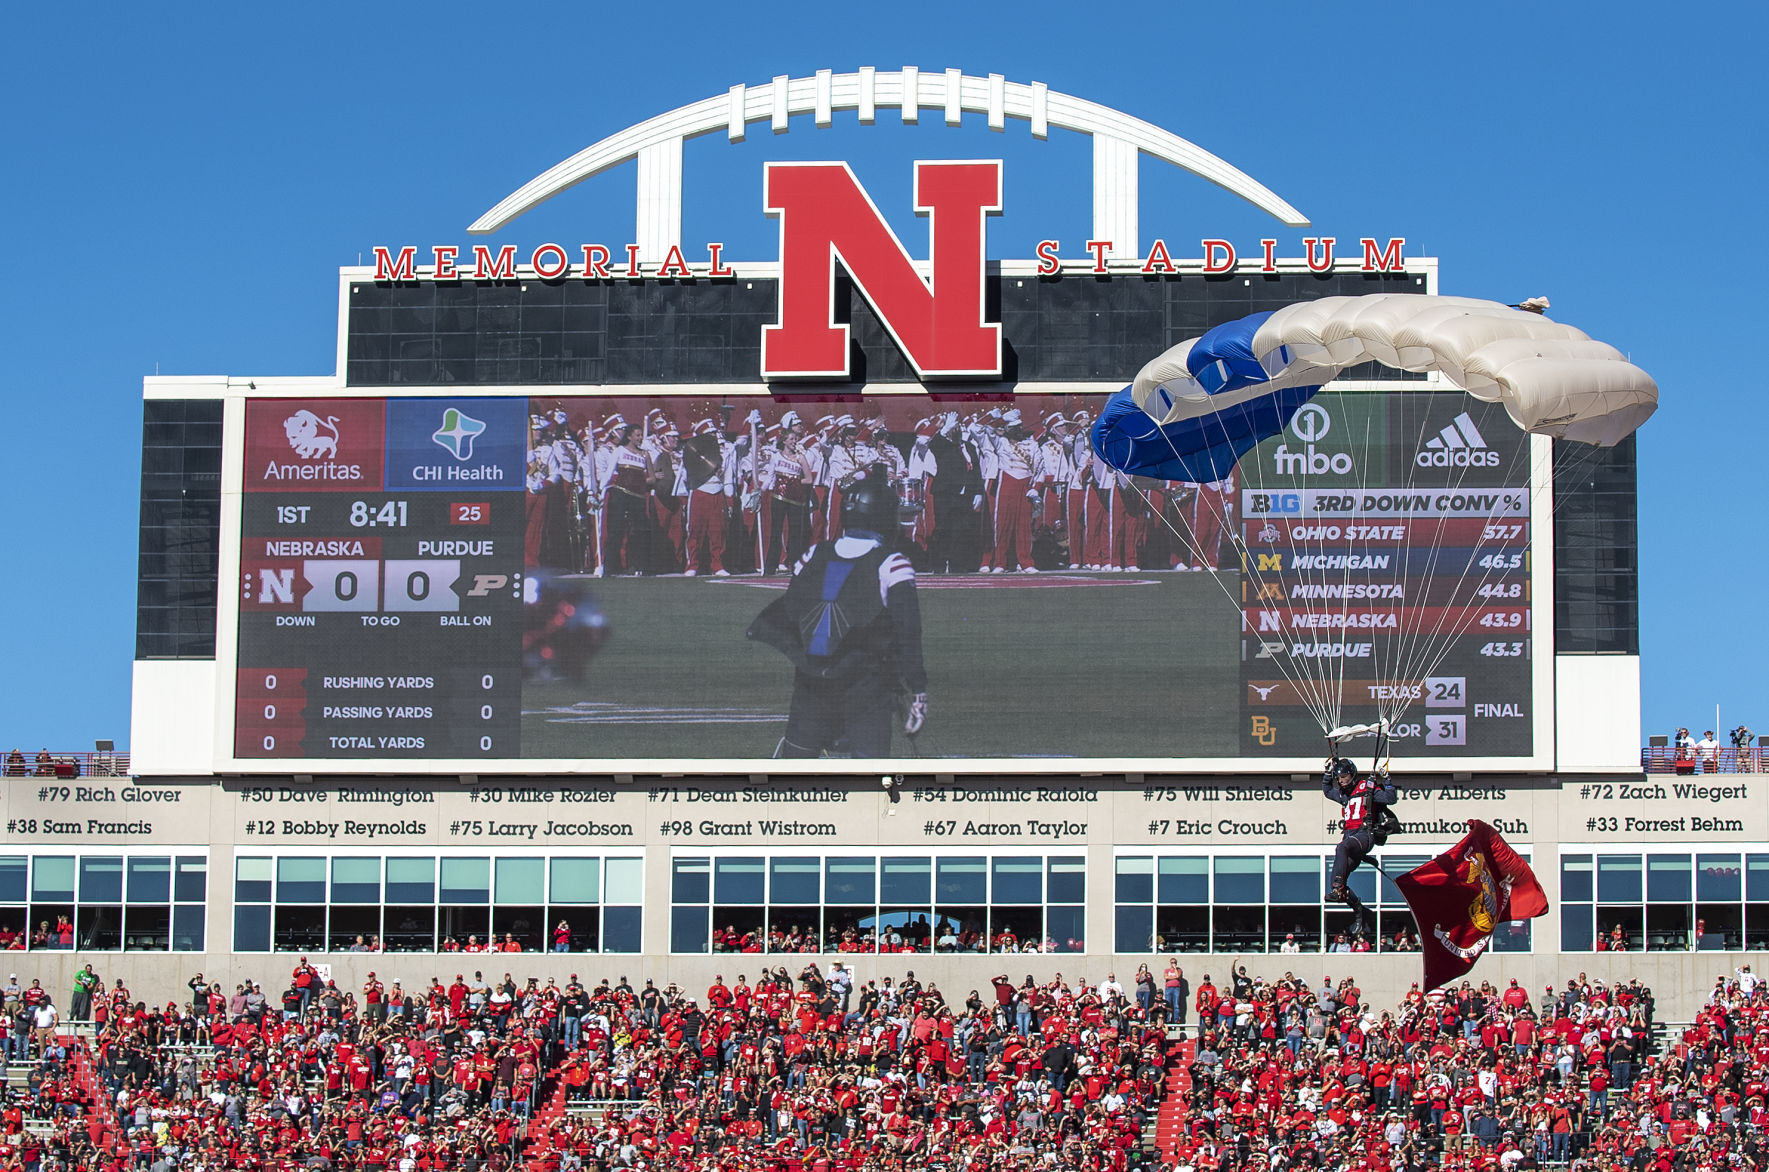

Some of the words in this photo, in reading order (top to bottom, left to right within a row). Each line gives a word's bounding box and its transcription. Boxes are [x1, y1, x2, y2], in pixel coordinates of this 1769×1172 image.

[373, 243, 733, 281] MEMORIAL
[1036, 237, 1405, 275] STADIUM
[761, 159, 1003, 376] N
[1274, 444, 1352, 474] fnbo
[1416, 448, 1500, 467] adidas
[263, 460, 361, 480] Ameritas
[412, 466, 442, 480] CHI
[448, 464, 504, 480] Health
[1313, 496, 1356, 512] 3RD
[1360, 496, 1433, 512] DOWN
[1435, 495, 1500, 511] CONV
[1503, 494, 1522, 511] %
[277, 506, 310, 524] 1ST
[350, 501, 408, 526] 8:41
[458, 506, 481, 522] 25
[1292, 526, 1340, 540] OHIO
[1344, 525, 1406, 540] STATE
[1482, 526, 1522, 540] 57.7
[266, 541, 364, 556] NEBRASKA
[418, 540, 494, 556] PURDUE
[1258, 554, 1282, 571] M
[1291, 556, 1390, 570] MICHIGAN
[1478, 555, 1522, 570] 46.5
[259, 568, 295, 604] N
[334, 570, 358, 601] 0
[406, 570, 430, 601] 0
[466, 574, 508, 597] P
[1291, 584, 1404, 599] MINNESOTA
[1478, 584, 1522, 598] 44.8
[276, 616, 316, 626] DOWN
[361, 616, 378, 626] TO
[380, 616, 400, 626] GO
[440, 616, 470, 626] BALL
[472, 616, 492, 626] ON
[1258, 610, 1281, 632] N
[1291, 614, 1398, 628] NEBRASKA
[1480, 613, 1522, 628] 43.9
[1291, 643, 1372, 658] PURDUE
[1480, 642, 1523, 658] 43.3
[265, 675, 277, 689] 0
[324, 676, 384, 688] RUSHING
[387, 676, 434, 688] YARDS
[482, 675, 494, 689] 0
[1368, 686, 1422, 698] TEXAS
[1434, 683, 1461, 700] 24
[264, 705, 276, 720] 0
[324, 706, 382, 718] PASSING
[386, 706, 433, 718] YARDS
[481, 705, 493, 720] 0
[1474, 704, 1524, 718] FINAL
[1438, 722, 1458, 739] 31
[263, 736, 275, 750] 0
[330, 736, 376, 748] TOTAL
[378, 736, 425, 748] YARDS
[480, 736, 492, 750] 0
[38, 786, 70, 802] #79
[76, 786, 116, 802] Rich
[121, 787, 182, 802] Glover
[240, 787, 273, 802] #50
[279, 788, 328, 802] Dave
[338, 788, 435, 806] Rimington
[470, 788, 502, 802] #30
[508, 788, 554, 802] Mike
[560, 788, 616, 802] Rozier
[648, 787, 679, 802] #71
[686, 788, 738, 802] Dean
[743, 788, 848, 802] Steinkuhler
[914, 787, 947, 802] #54
[952, 787, 1032, 802] Dominic
[1037, 787, 1098, 802] Raiola
[1144, 786, 1176, 802] #75
[1182, 786, 1220, 801] Will
[1226, 786, 1293, 801] Shields
[1438, 785, 1506, 800] Alberts
[1580, 784, 1614, 800] #72
[1620, 784, 1666, 799] Zach
[1673, 784, 1748, 802] Wiegert
[7, 820, 38, 834] #38
[43, 820, 82, 834] Sam
[87, 820, 152, 834] Francis
[246, 820, 275, 835] #12
[282, 820, 340, 838] Bobby
[344, 820, 426, 838] Reynolds
[450, 820, 482, 836] #75
[488, 820, 538, 840] Larry
[543, 820, 634, 836] Jacobson
[660, 820, 692, 836] #98
[699, 820, 752, 836] Grant
[758, 820, 836, 836] Wistrom
[924, 820, 956, 836] #67
[962, 820, 1022, 836] Aaron
[1027, 820, 1088, 838] Taylor
[1148, 820, 1170, 834] #7
[1176, 820, 1212, 834] Eric
[1218, 820, 1288, 834] Crouch
[1493, 819, 1528, 834] Suh
[1586, 817, 1618, 832] #33
[1625, 817, 1686, 832] Forrest
[1691, 817, 1744, 832] Behm
